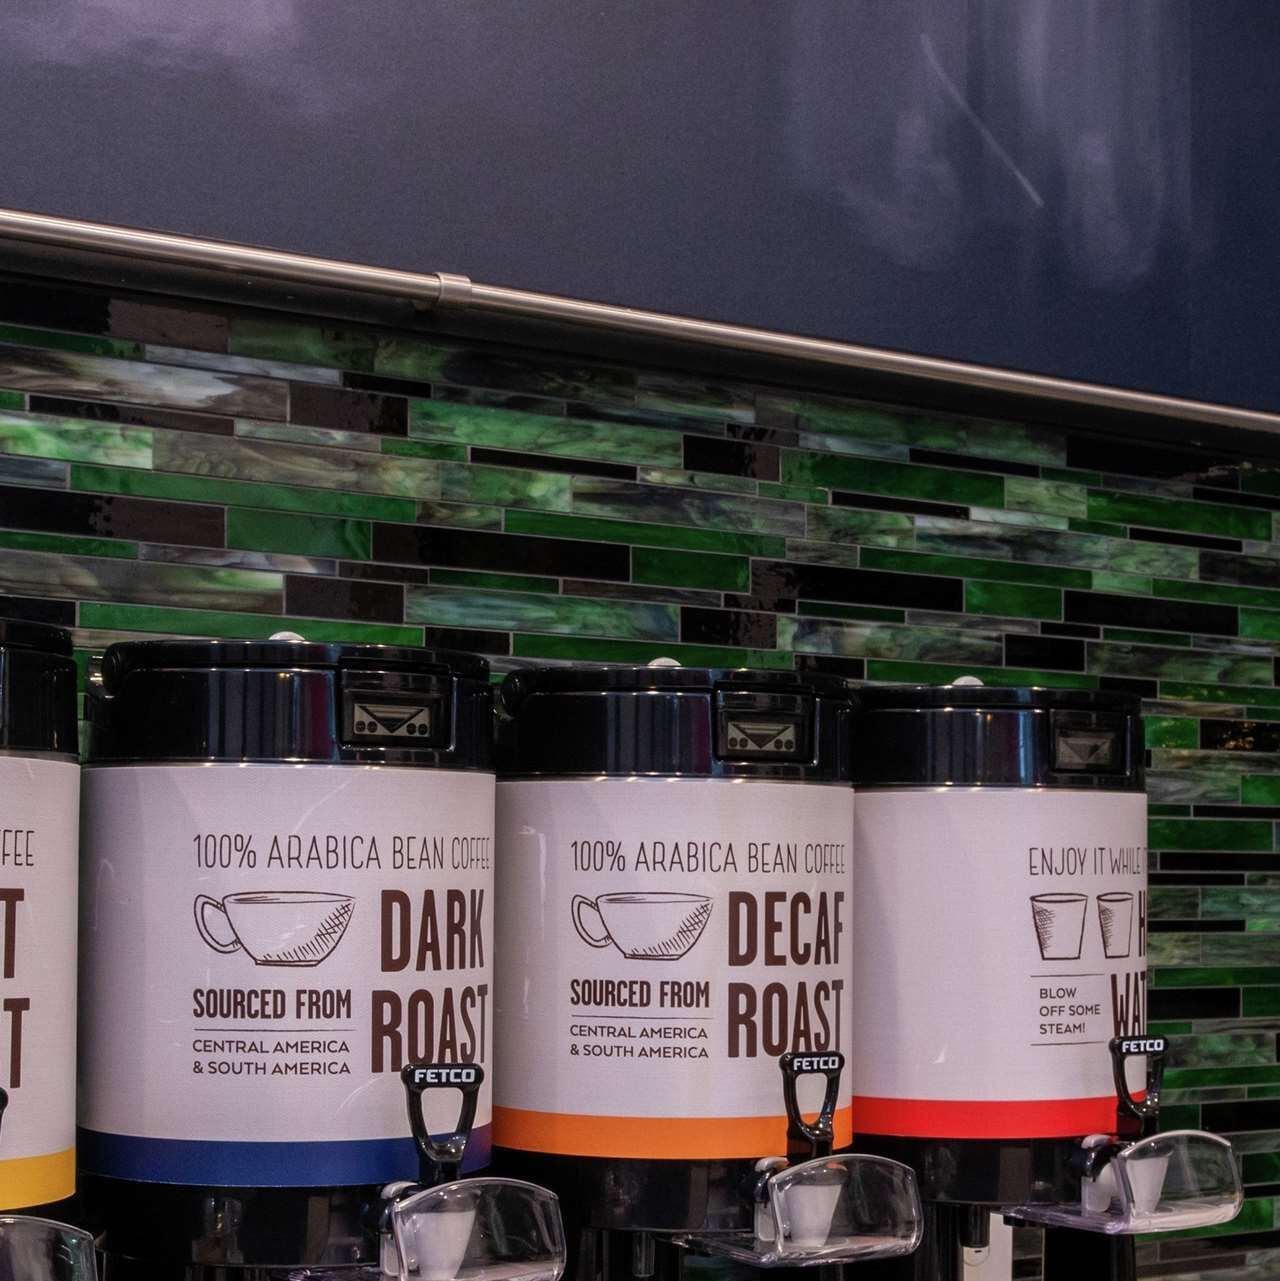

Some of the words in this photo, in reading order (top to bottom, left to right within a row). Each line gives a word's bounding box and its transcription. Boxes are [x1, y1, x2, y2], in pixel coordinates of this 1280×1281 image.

[193, 833, 257, 869] 100%
[268, 834, 382, 870] ARABICA
[392, 835, 444, 870] BEAN
[451, 835, 491, 871] COFFEE
[570, 839, 626, 873] 100%
[634, 840, 738, 874] ARABICA
[748, 842, 798, 874] BEAN
[805, 843, 845, 875] COFFEE
[1029, 846, 1087, 876] ENJOY
[1093, 846, 1106, 876] IT
[1109, 846, 1141, 875] WHILE
[380, 888, 485, 973] DARK
[727, 890, 844, 968] DECAF
[570, 979, 651, 1008] SOURCED
[659, 980, 710, 1009] FROM
[1039, 987, 1077, 999] BLOW
[192, 988, 286, 1020] SOURCED
[295, 988, 352, 1020] FROM
[1039, 1005, 1066, 1017] OFF
[1068, 1004, 1101, 1017] SOME
[727, 979, 844, 1059] ROAST
[371, 983, 489, 1073] ROAST
[570, 1024, 637, 1039] CENTRAL
[639, 1025, 708, 1040] AMERICA
[1039, 1023, 1086, 1035] STEAM!
[192, 1038, 269, 1054] CENTRAL
[271, 1039, 350, 1054] AMERICA
[570, 1044, 580, 1057] &
[582, 1043, 636, 1059] SOUTH
[640, 1045, 709, 1059] AMERICA
[1122, 1038, 1164, 1054] FETCO
[192, 1061, 205, 1074] &
[207, 1060, 266, 1075] SOUTH
[271, 1061, 351, 1075] AMERICA
[793, 1056, 840, 1071] FETCO
[414, 1068, 476, 1084] FETCO
